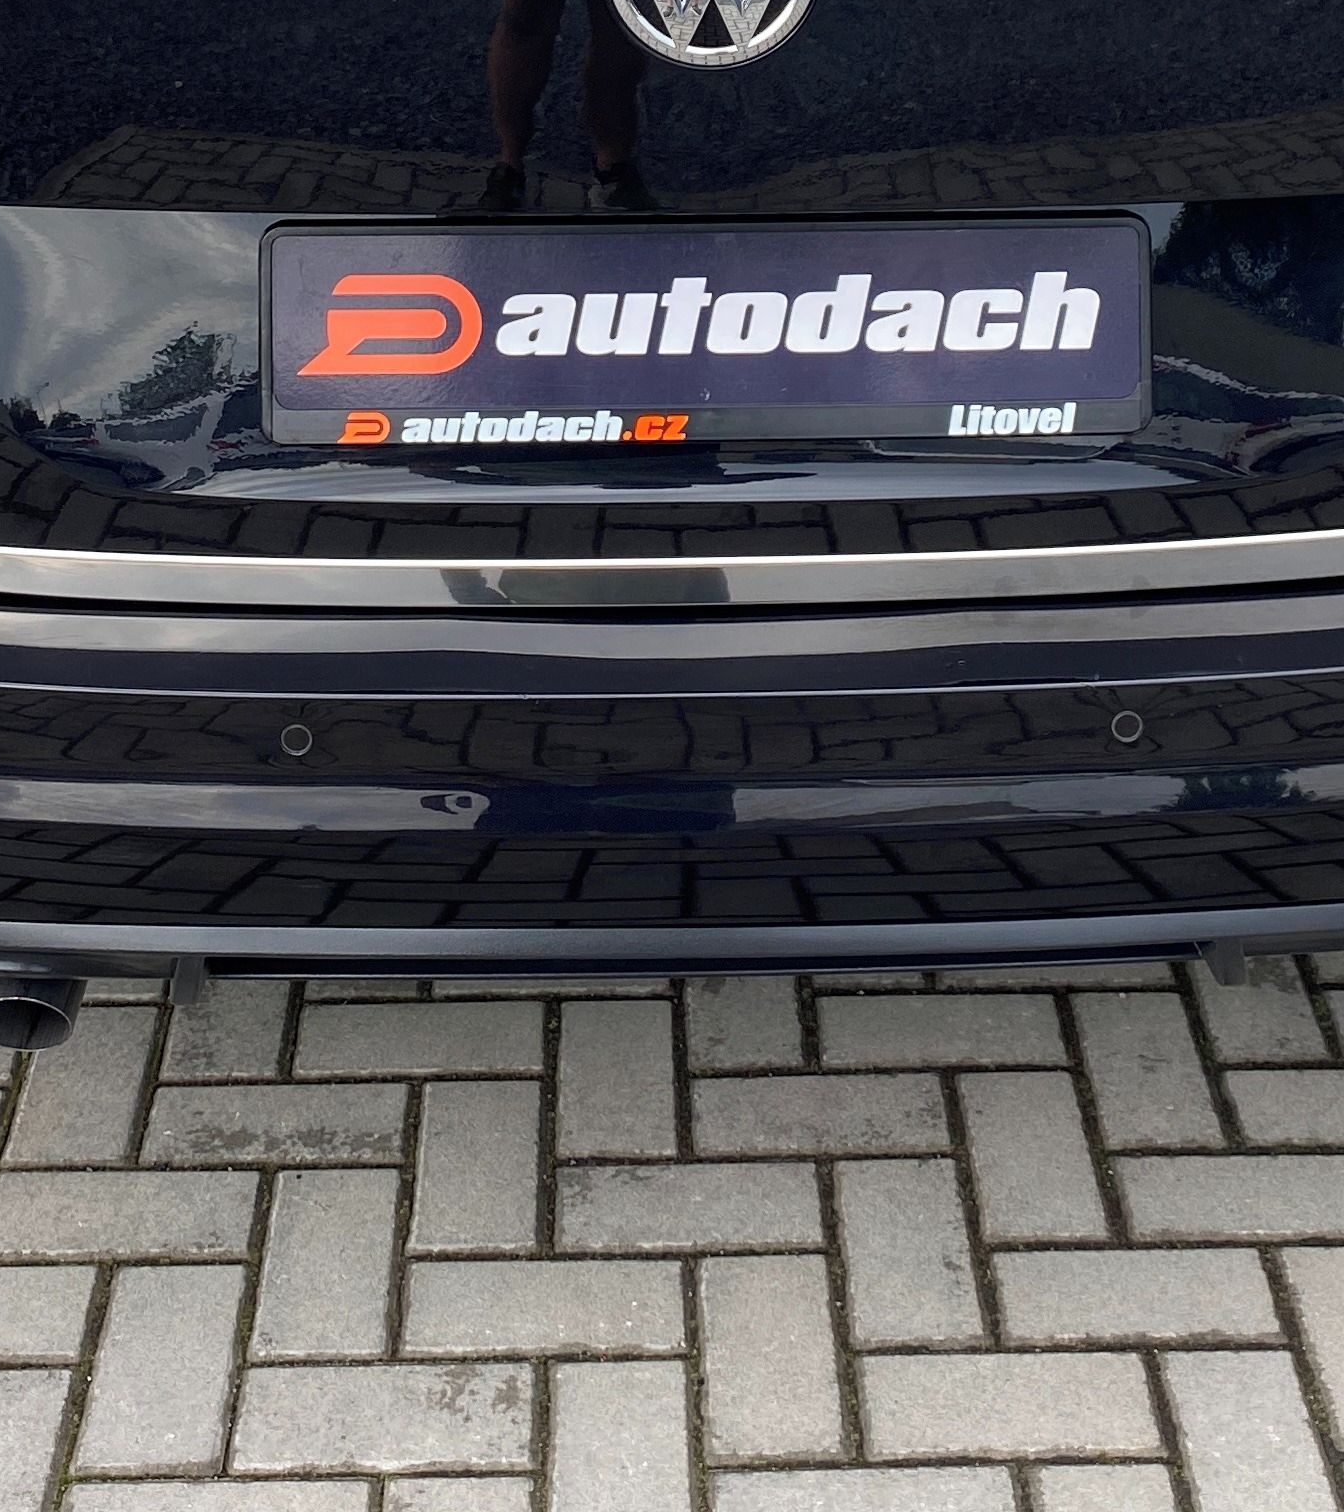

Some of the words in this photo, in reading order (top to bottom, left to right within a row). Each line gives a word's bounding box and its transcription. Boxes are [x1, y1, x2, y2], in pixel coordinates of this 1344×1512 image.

[495, 271, 1102, 356] autodach
[401, 410, 687, 444] autodach.cz
[949, 402, 1076, 436] Litovel
